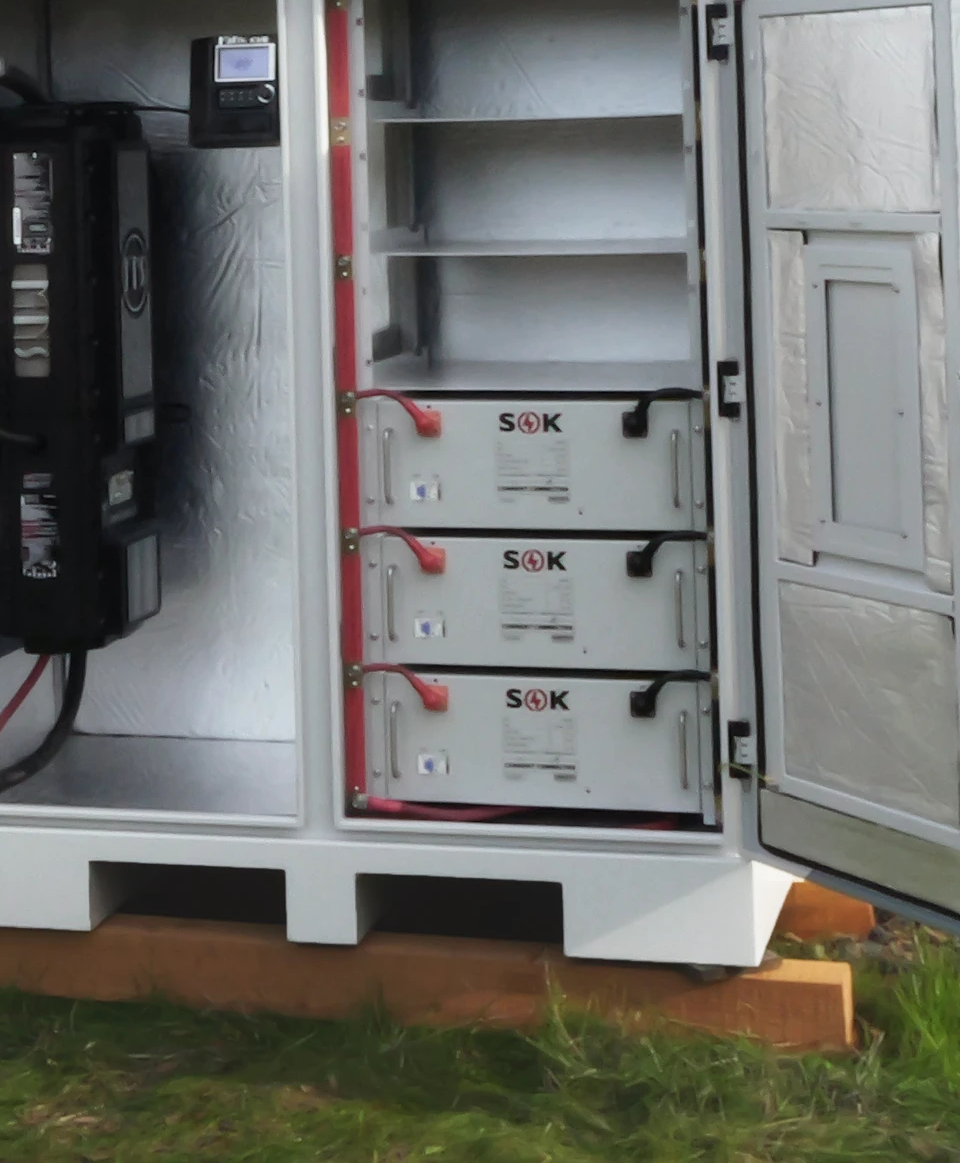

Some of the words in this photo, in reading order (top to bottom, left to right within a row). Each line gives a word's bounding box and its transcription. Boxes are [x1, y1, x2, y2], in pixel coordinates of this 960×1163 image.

[498, 411, 563, 434] SOK
[503, 549, 567, 573] SOK
[506, 688, 570, 712] SOK
